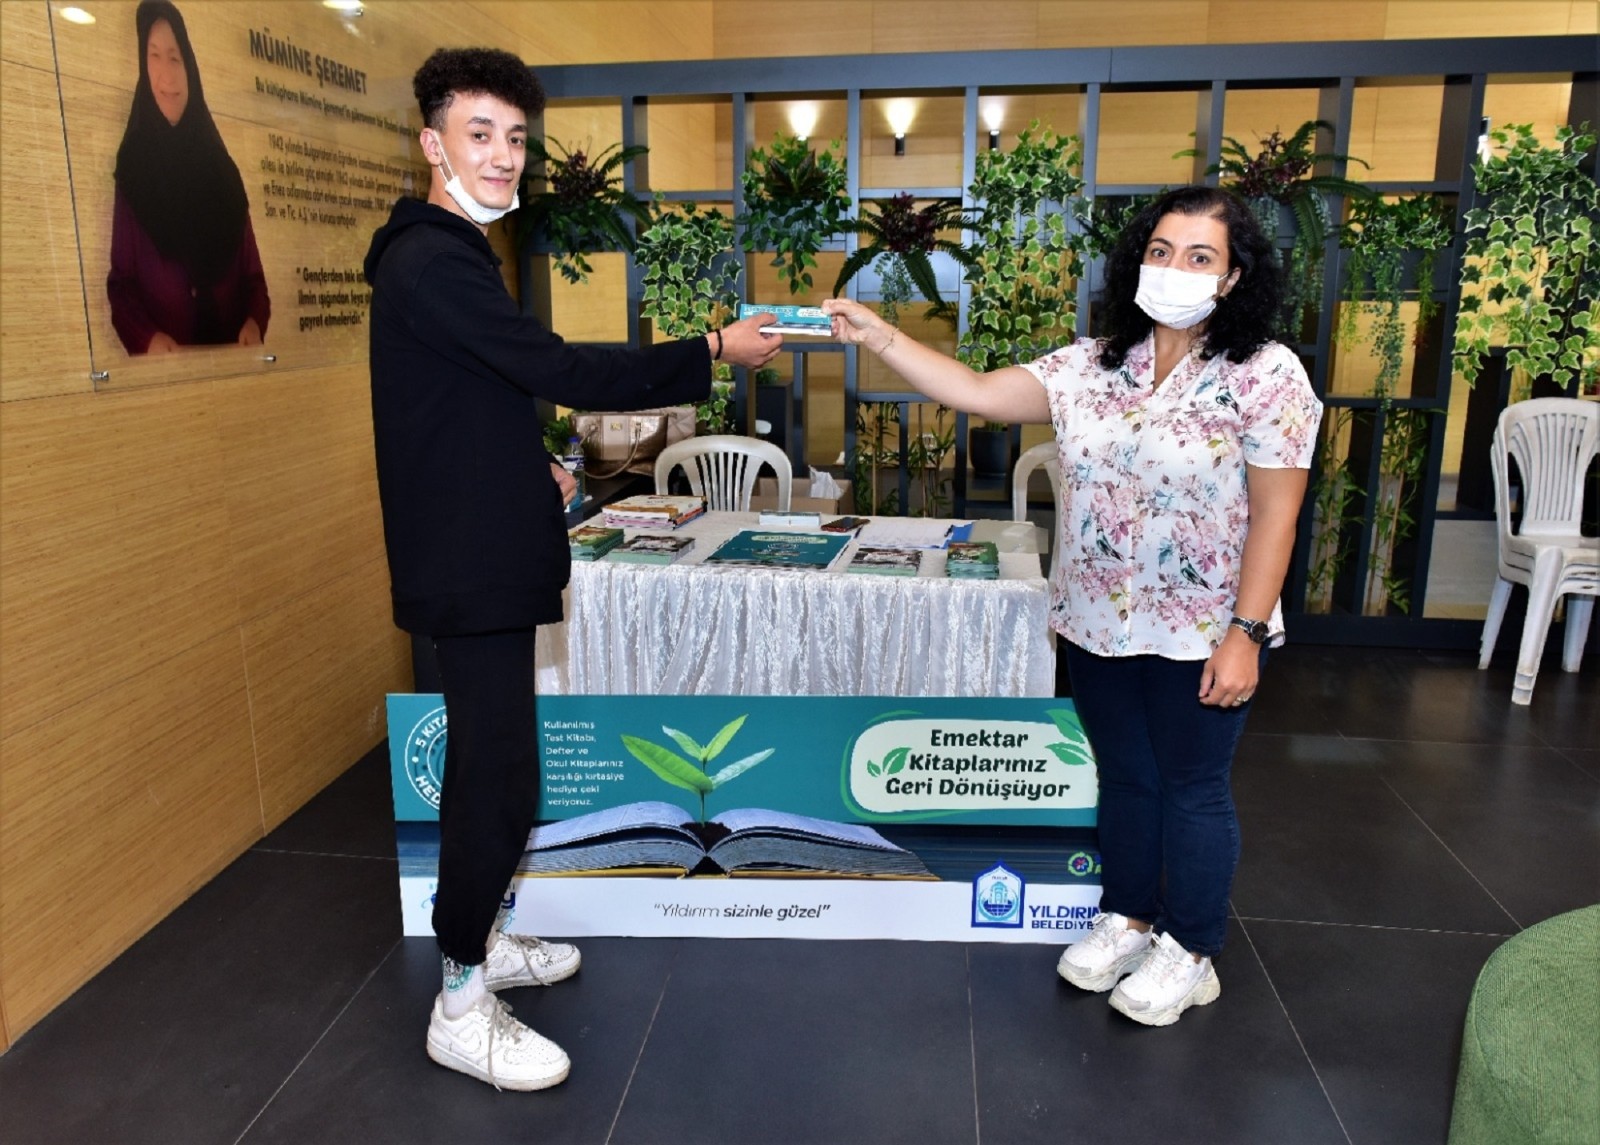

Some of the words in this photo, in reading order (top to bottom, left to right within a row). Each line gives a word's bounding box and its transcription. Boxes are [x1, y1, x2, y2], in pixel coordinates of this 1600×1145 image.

[249, 26, 312, 76] MÜMİNE
[315, 54, 367, 95] ŞEREMET
[268, 133, 284, 151] 1942
[544, 720, 595, 730] Kullanılmış
[415, 736, 427, 748] 5
[544, 733, 564, 742] Test
[930, 729, 1029, 748] Emektar
[545, 746, 575, 755] Defter
[545, 760, 568, 768] Okul
[570, 760, 624, 769] Kitaplarınız
[909, 753, 1048, 775] Kitaplarınız
[585, 772, 625, 782] kırtasiye
[547, 785, 578, 794] hediye
[580, 785, 600, 794] çeki
[885, 778, 933, 796] Geri
[939, 777, 1071, 801] Dönüşüyor
[723, 903, 773, 918] sizinle
